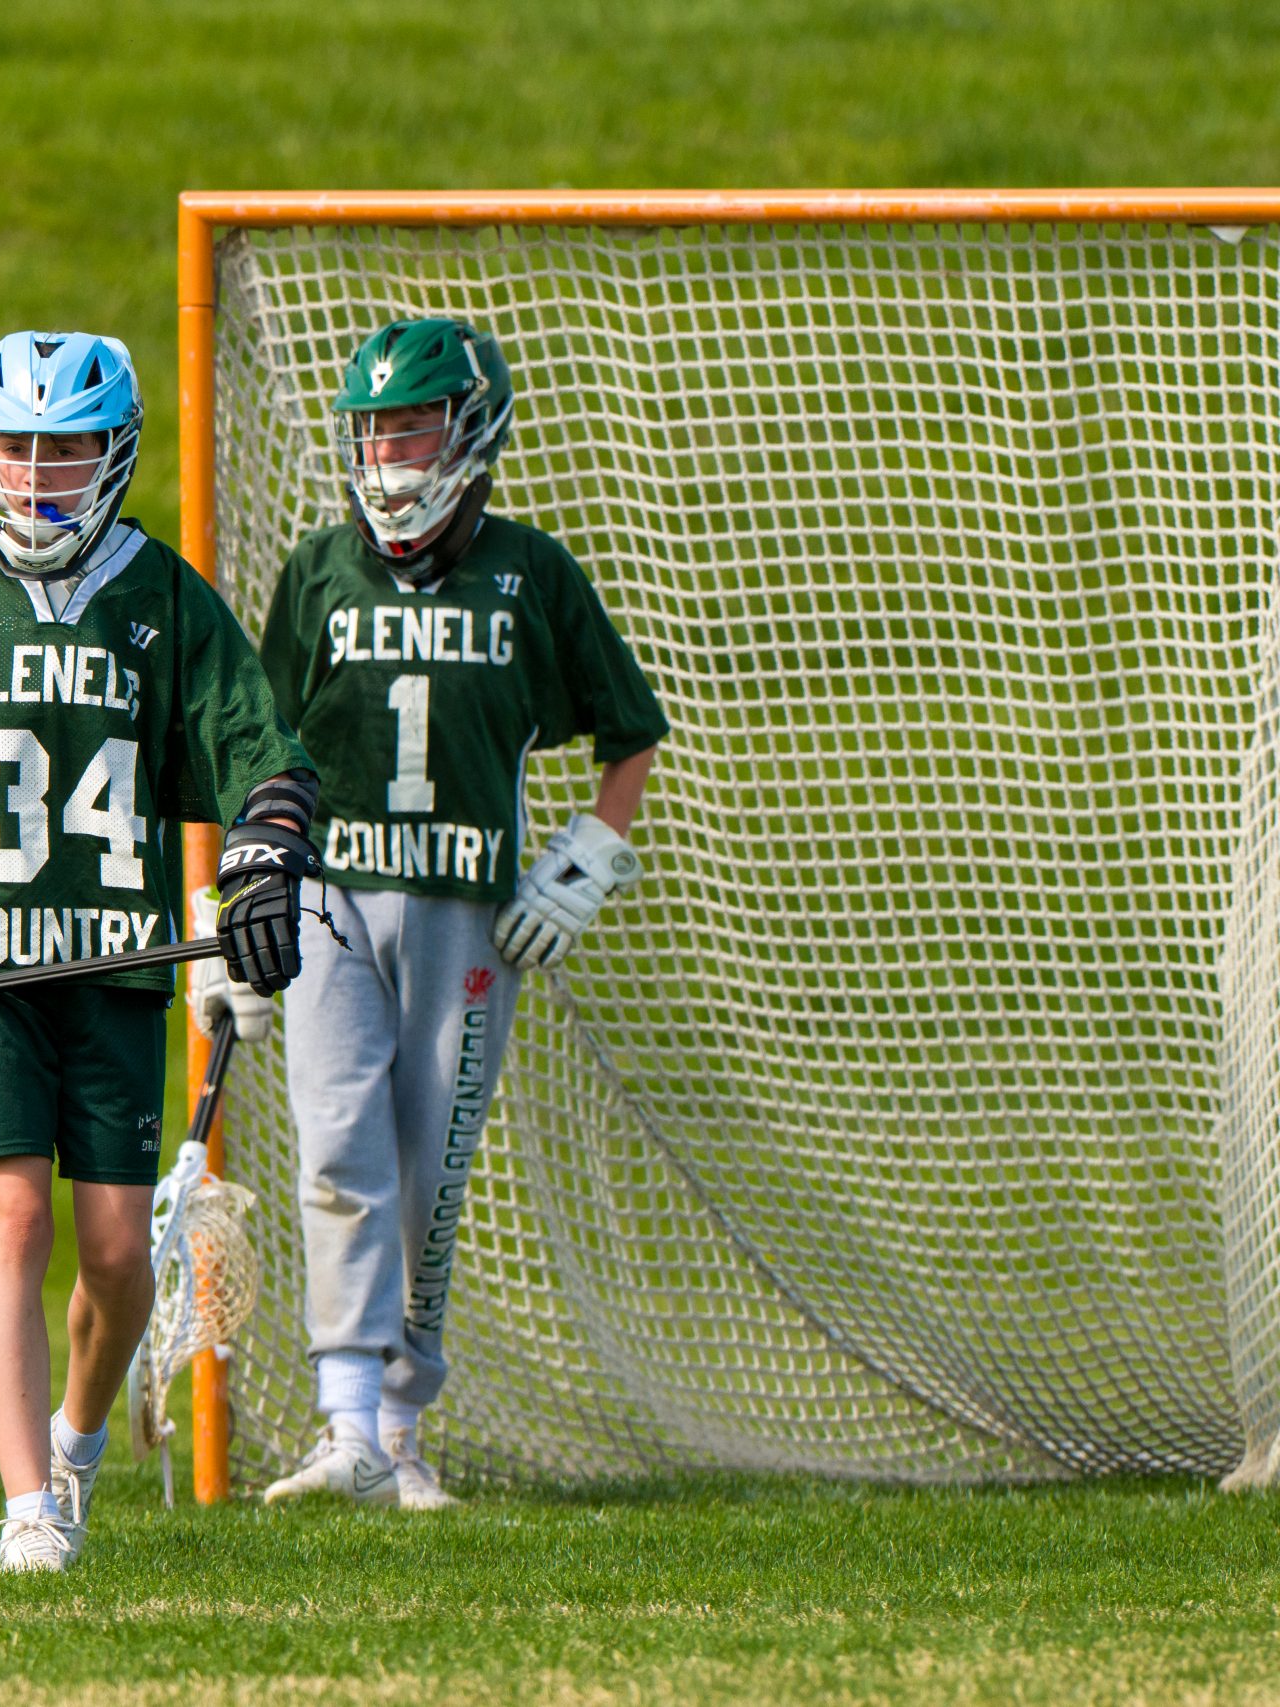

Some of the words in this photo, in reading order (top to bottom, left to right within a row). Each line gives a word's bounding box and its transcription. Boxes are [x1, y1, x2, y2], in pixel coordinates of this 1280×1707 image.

[387, 674, 435, 813] 1
[219, 844, 289, 874] STX
[324, 817, 505, 883] COUNTRY
[444, 1010, 486, 1169] GLENELG
